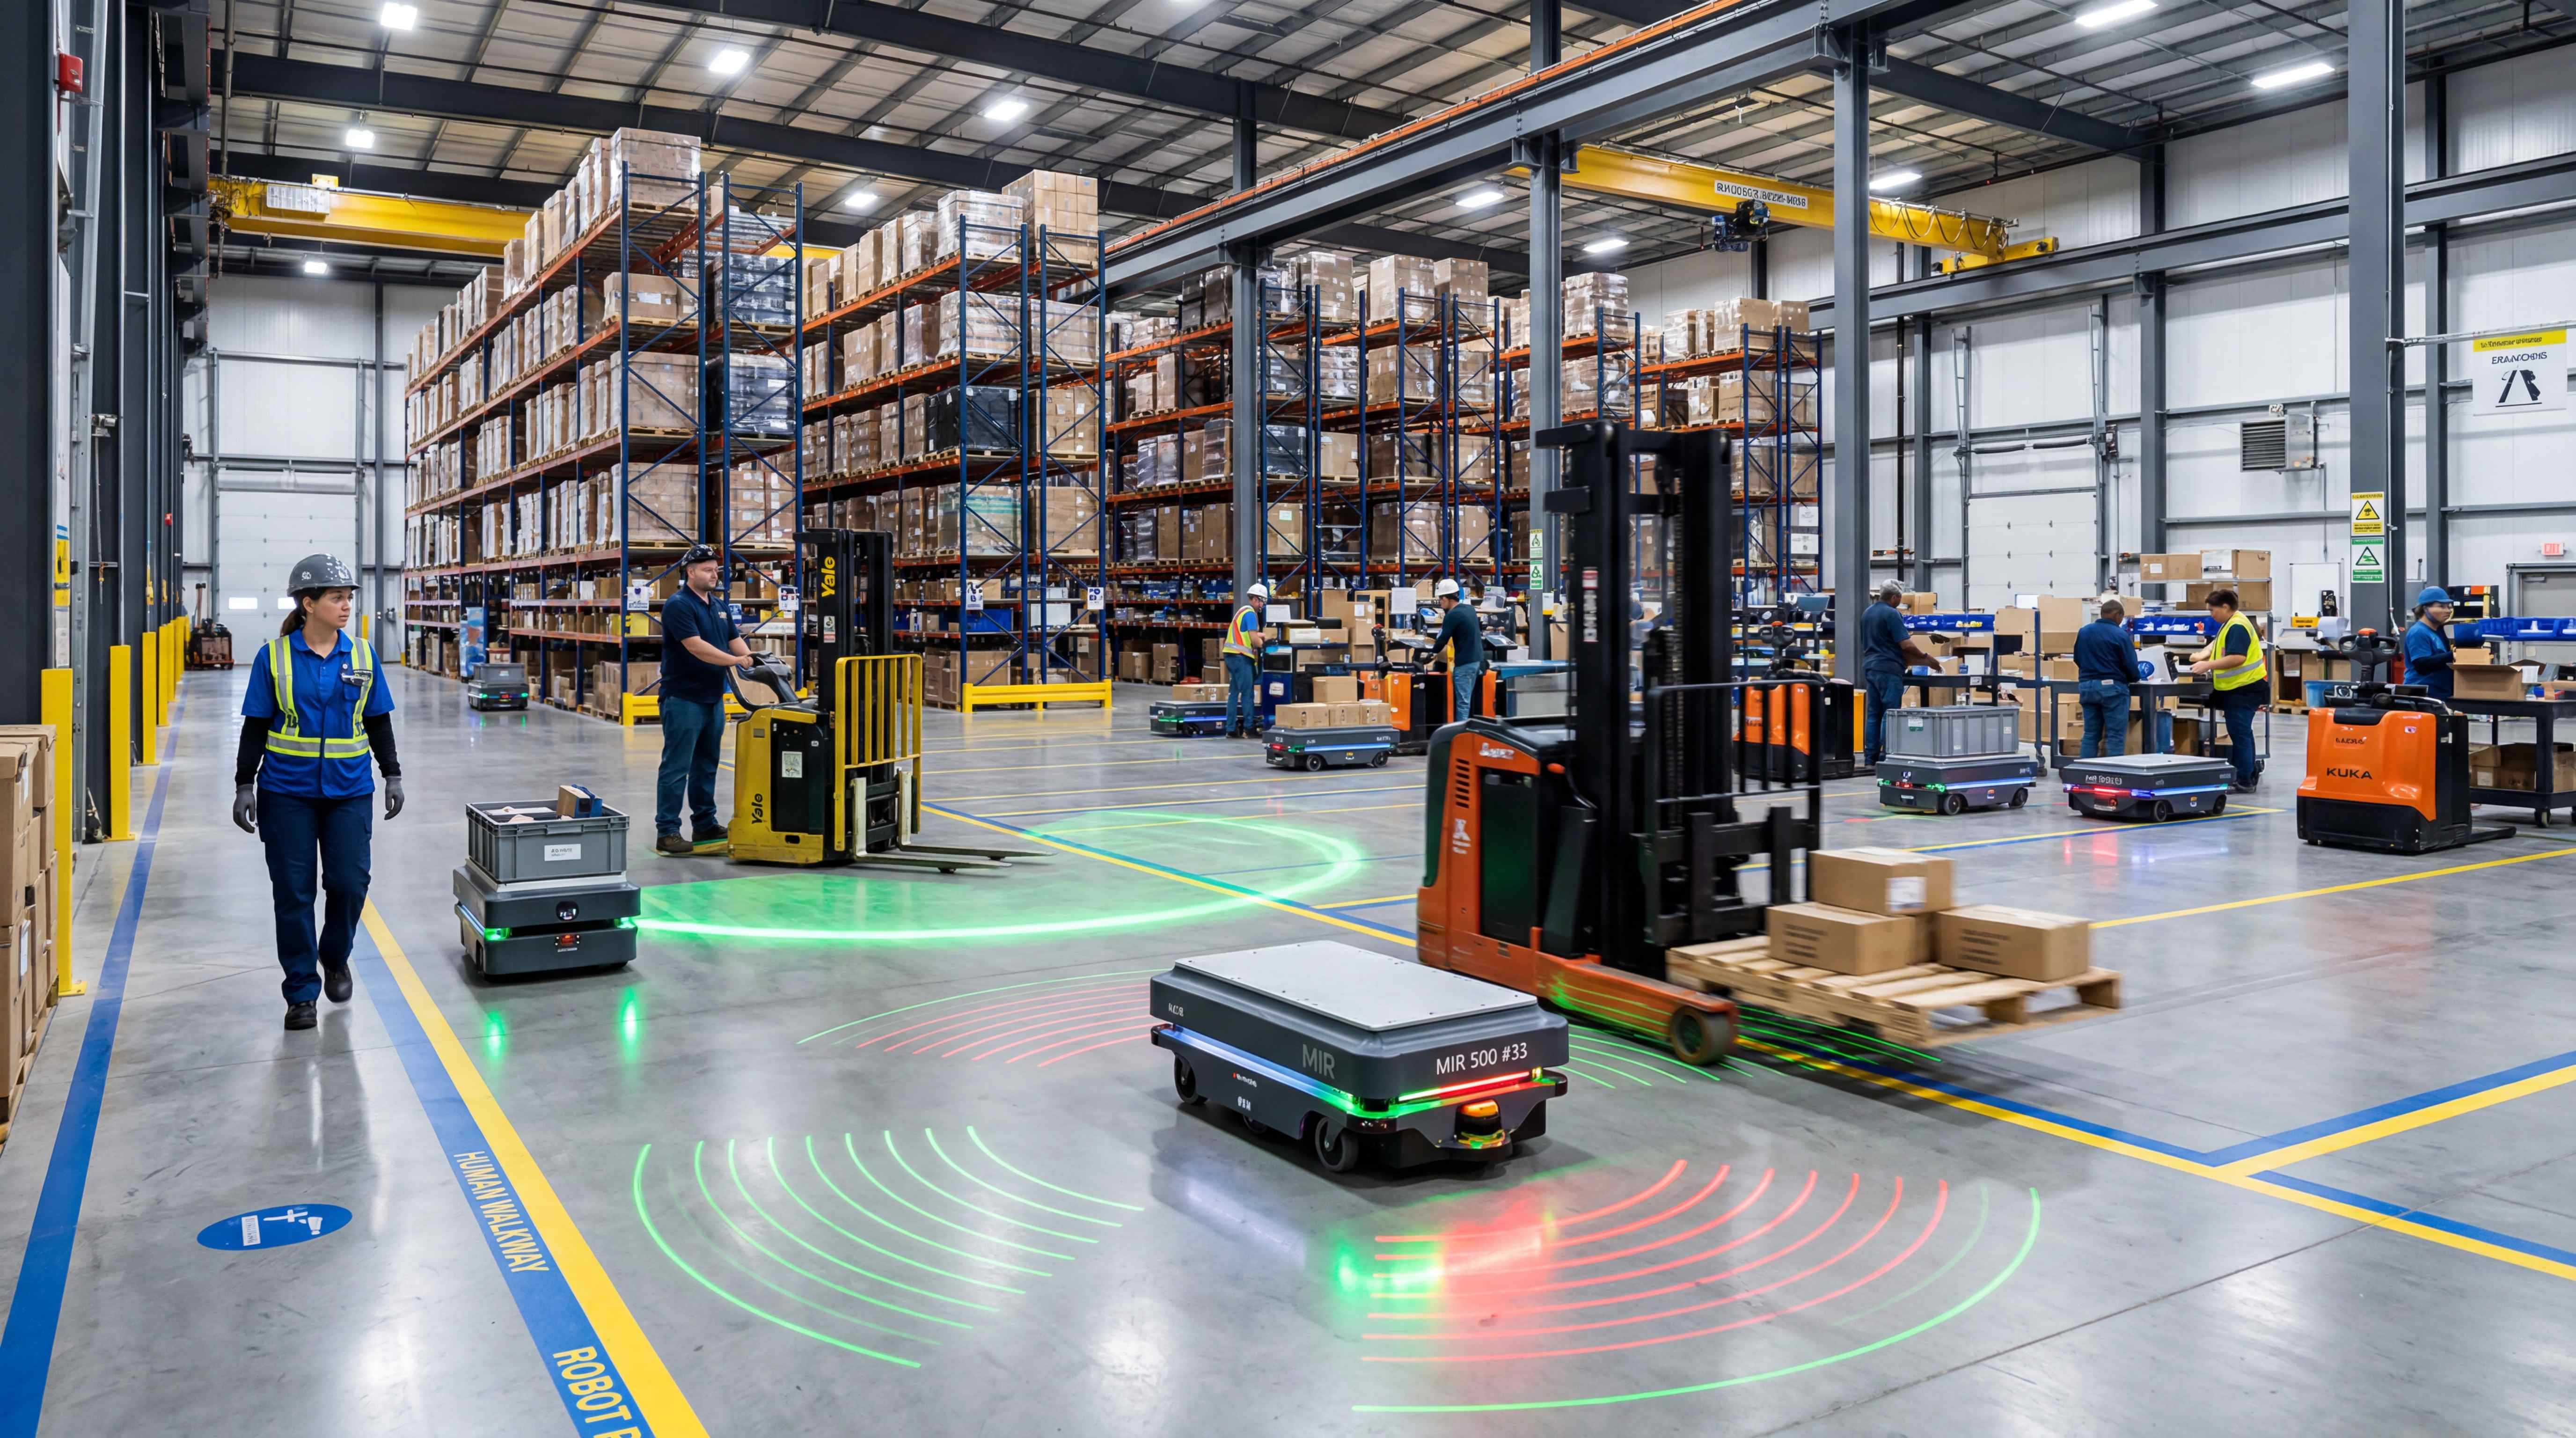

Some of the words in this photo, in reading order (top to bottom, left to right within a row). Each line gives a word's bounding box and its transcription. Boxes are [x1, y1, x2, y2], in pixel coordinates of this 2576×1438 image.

[2327, 767, 2372, 779] KUKA
[1303, 1044, 1335, 1079] MIR
[1436, 1054, 1466, 1075] MIR
[1471, 1048, 1497, 1068] 500
[1502, 1042, 1527, 1062] #33
[454, 1151, 509, 1200] HUMAN
[480, 1199, 549, 1273] WALKWAY
[552, 1346, 632, 1423] ROBOT
